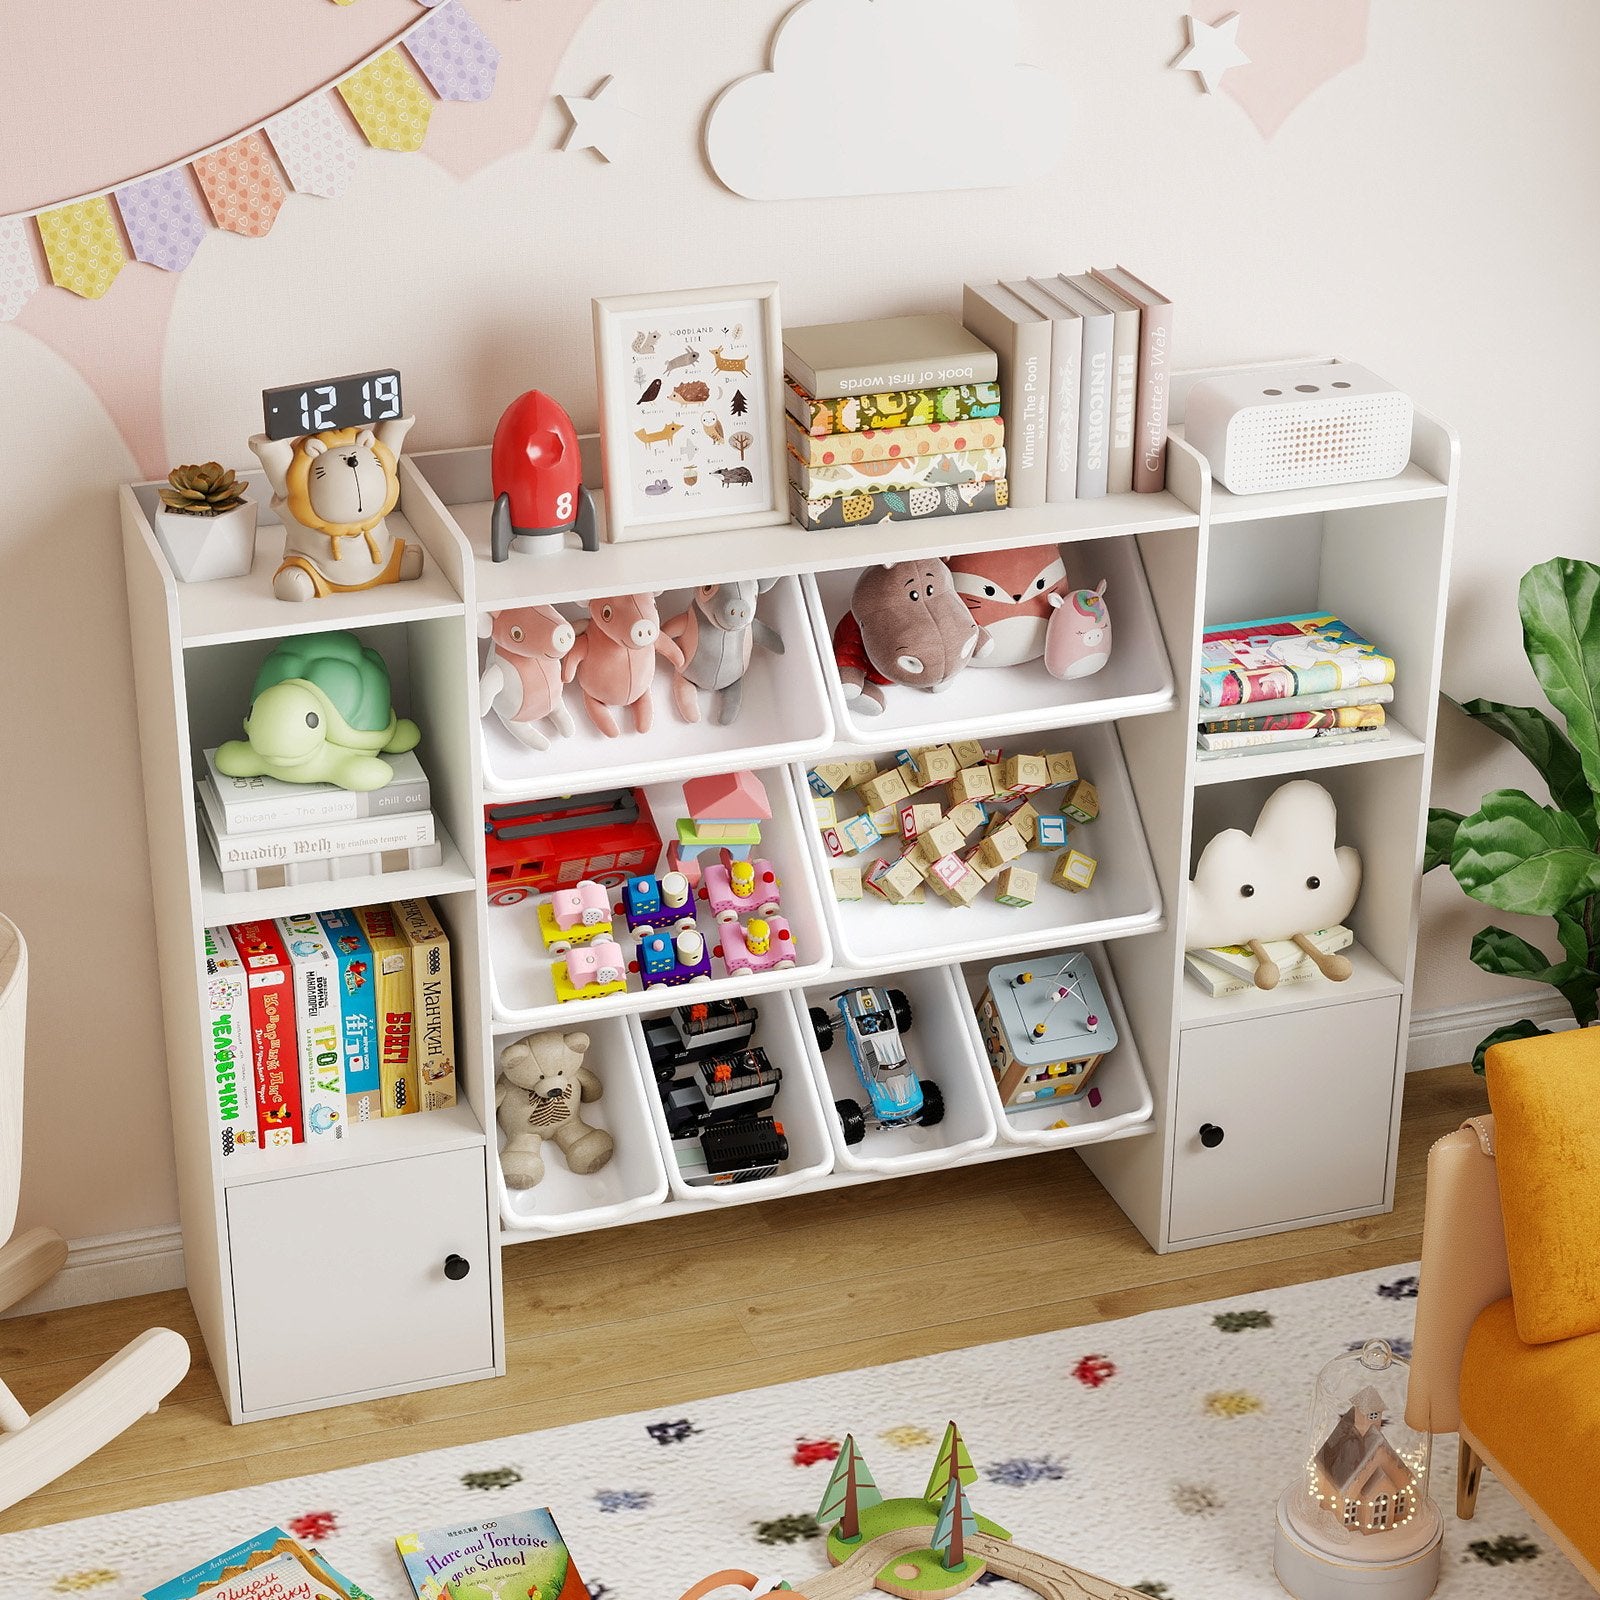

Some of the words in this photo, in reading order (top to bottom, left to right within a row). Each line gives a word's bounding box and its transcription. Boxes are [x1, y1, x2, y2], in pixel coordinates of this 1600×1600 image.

[669, 326, 714, 338] WOODLAND
[1151, 326, 1166, 367] Web
[840, 376, 884, 391] words
[888, 373, 914, 387] first
[920, 371, 934, 385] of
[938, 367, 973, 382] book
[1024, 356, 1038, 392] Pooh
[300, 385, 337, 430] 12
[362, 375, 399, 419] 19
[1024, 395, 1036, 420] The
[1087, 351, 1106, 471] UNICORNS
[1115, 354, 1134, 448] EARTH
[1022, 423, 1035, 470] Winnie
[556, 491, 573, 520] 8
[234, 812, 277, 825] Chicane
[297, 807, 315, 816] The
[321, 802, 356, 816] galaxy
[379, 796, 400, 807] chill
[405, 793, 422, 804] out
[422, 981, 442, 1056] Манчкин
[383, 1012, 412, 1064] БЭНГ!
[314, 1024, 340, 1093] ГРОГУ
[269, 1072, 284, 1103] Лис
[425, 1549, 462, 1576] Hare
[464, 1540, 484, 1556] and
[483, 1531, 548, 1548] Tortoise
[451, 1571, 464, 1587] go
[465, 1565, 476, 1576] to
[475, 1551, 526, 1571] School
